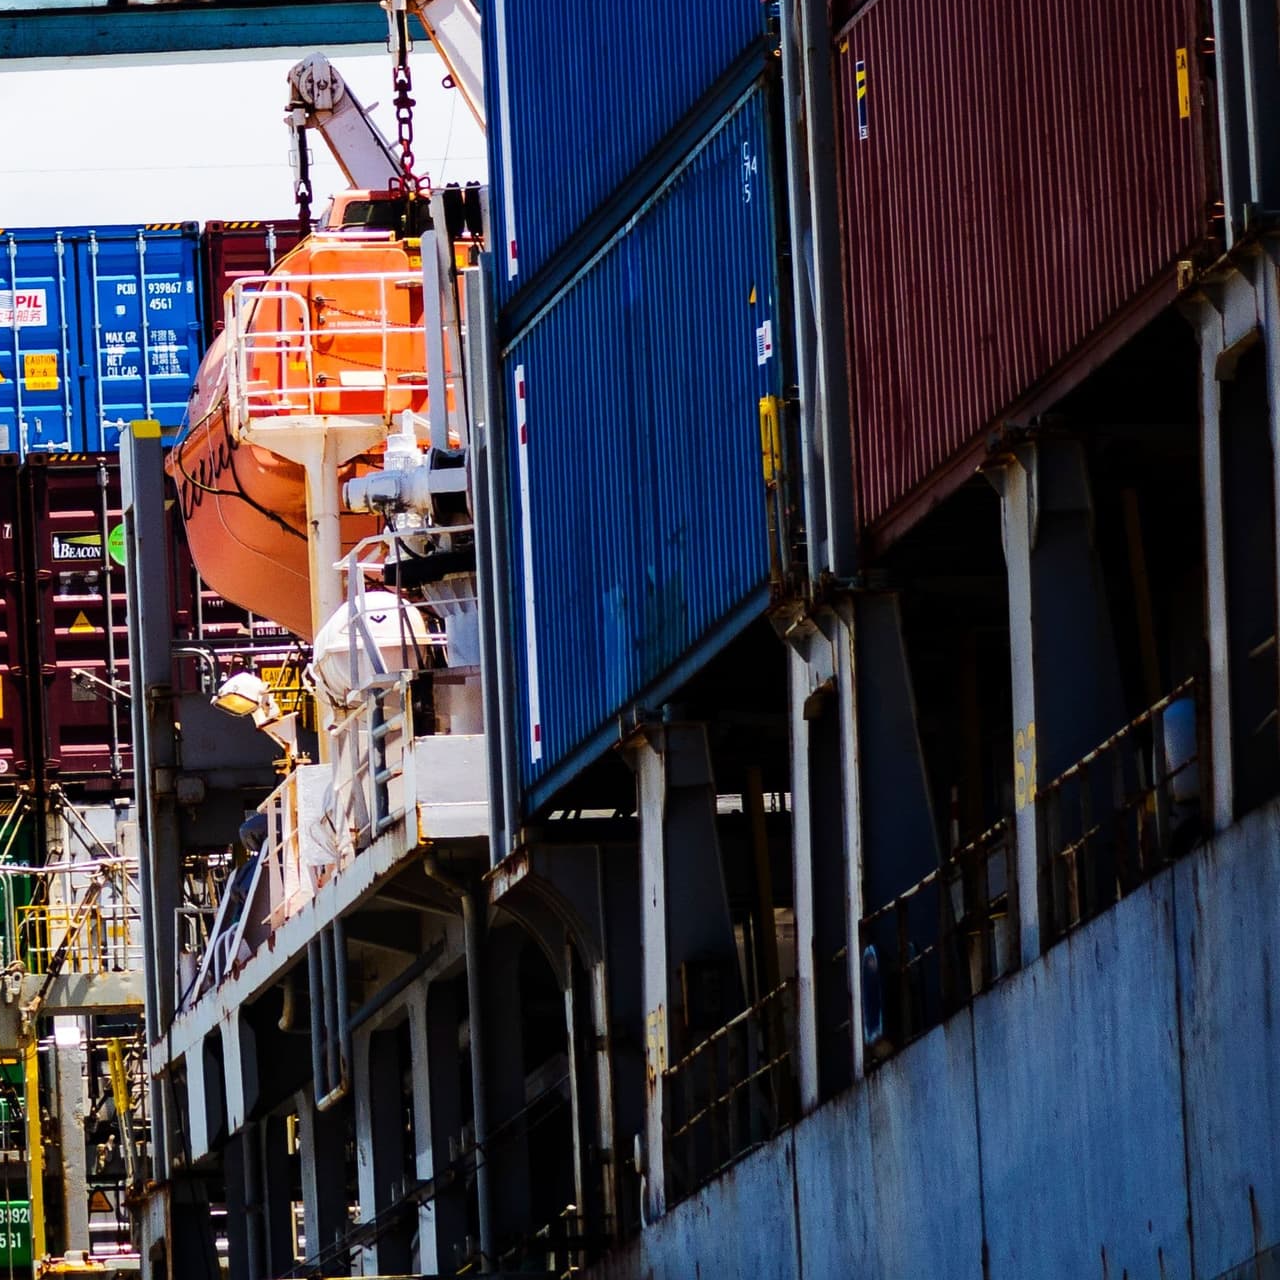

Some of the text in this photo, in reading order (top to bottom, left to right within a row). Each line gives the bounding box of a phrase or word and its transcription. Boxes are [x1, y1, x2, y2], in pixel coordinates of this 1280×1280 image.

[116, 283, 137, 296] PCIU
[148, 281, 182, 294] 939867
[15, 295, 42, 308] PIL
[149, 298, 172, 310] 45G1
[25, 356, 56, 365] CAUTION
[3, 524, 13, 539] 7
